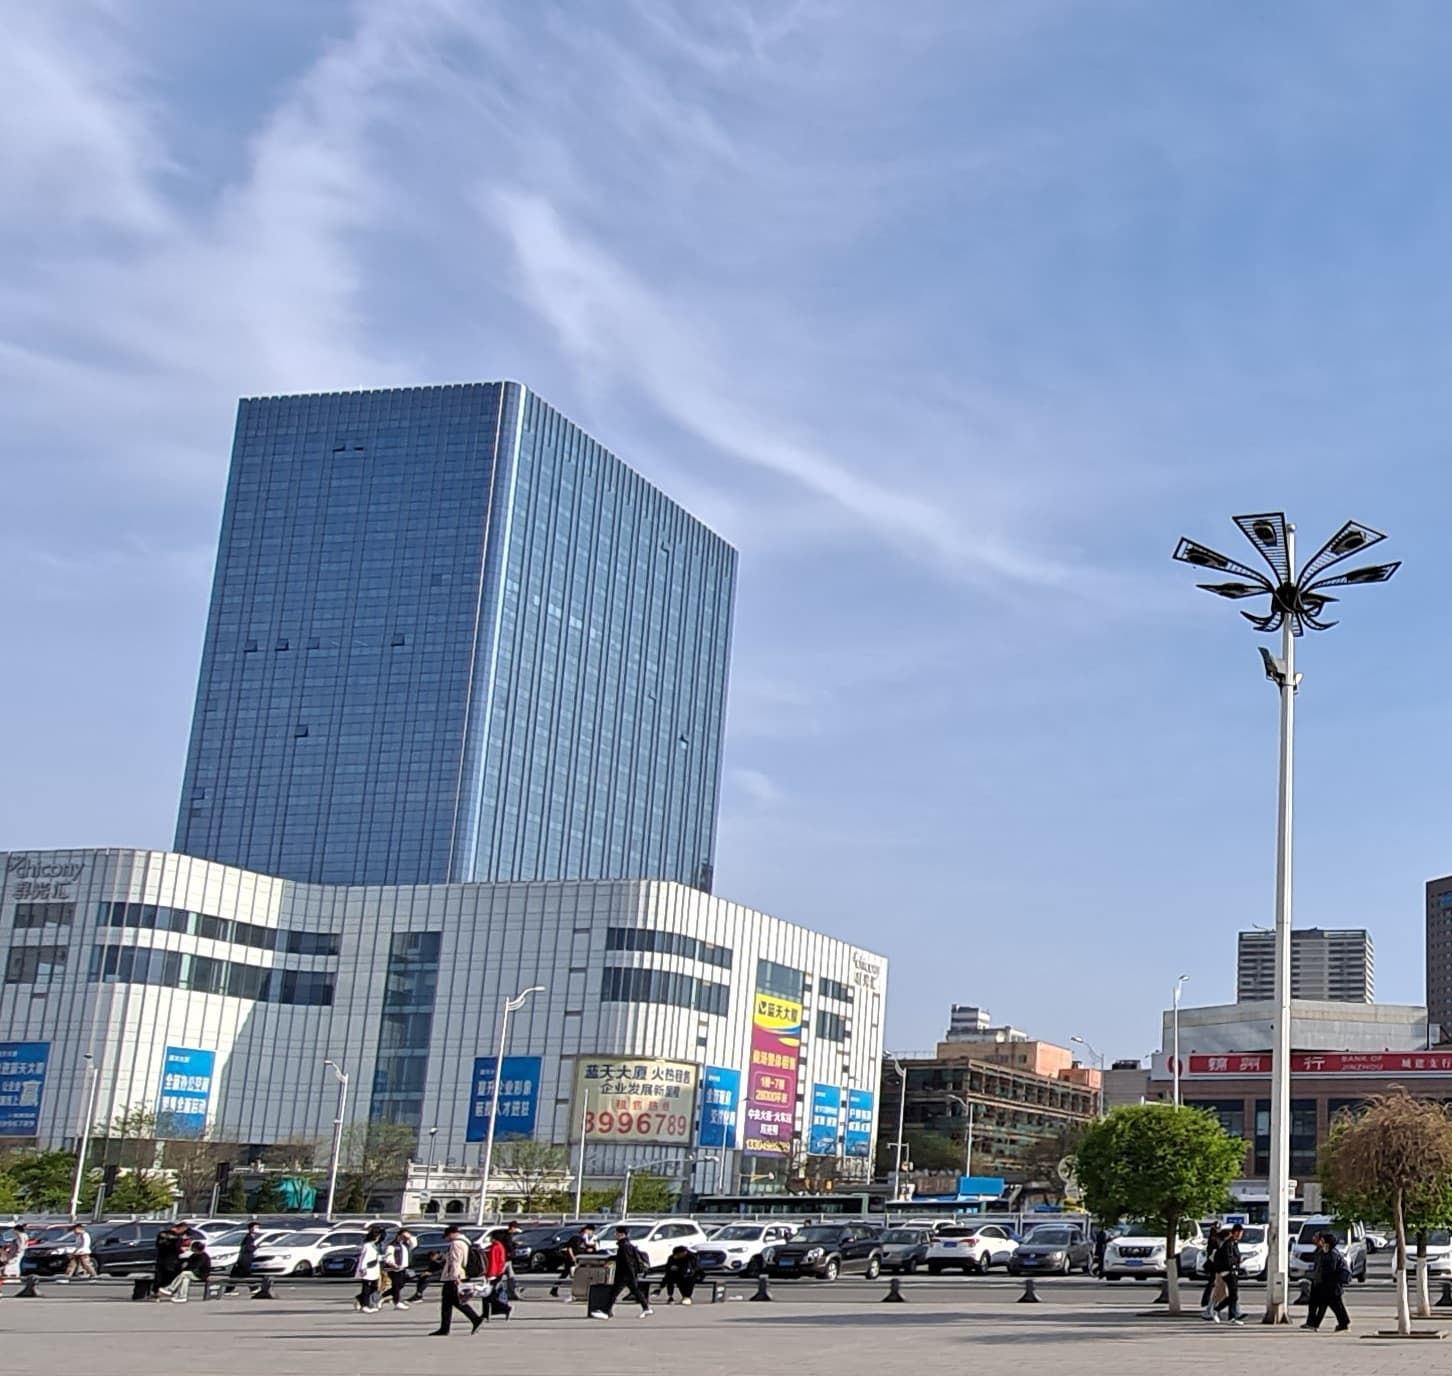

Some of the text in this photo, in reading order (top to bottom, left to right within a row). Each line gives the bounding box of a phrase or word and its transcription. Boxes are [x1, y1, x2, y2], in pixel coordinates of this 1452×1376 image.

[15, 858, 86, 881] chicony
[1207, 1056, 1326, 1071] 锦州行
[1342, 1063, 1384, 1071] JINZHOU
[584, 1064, 648, 1080] 蓝天大厦
